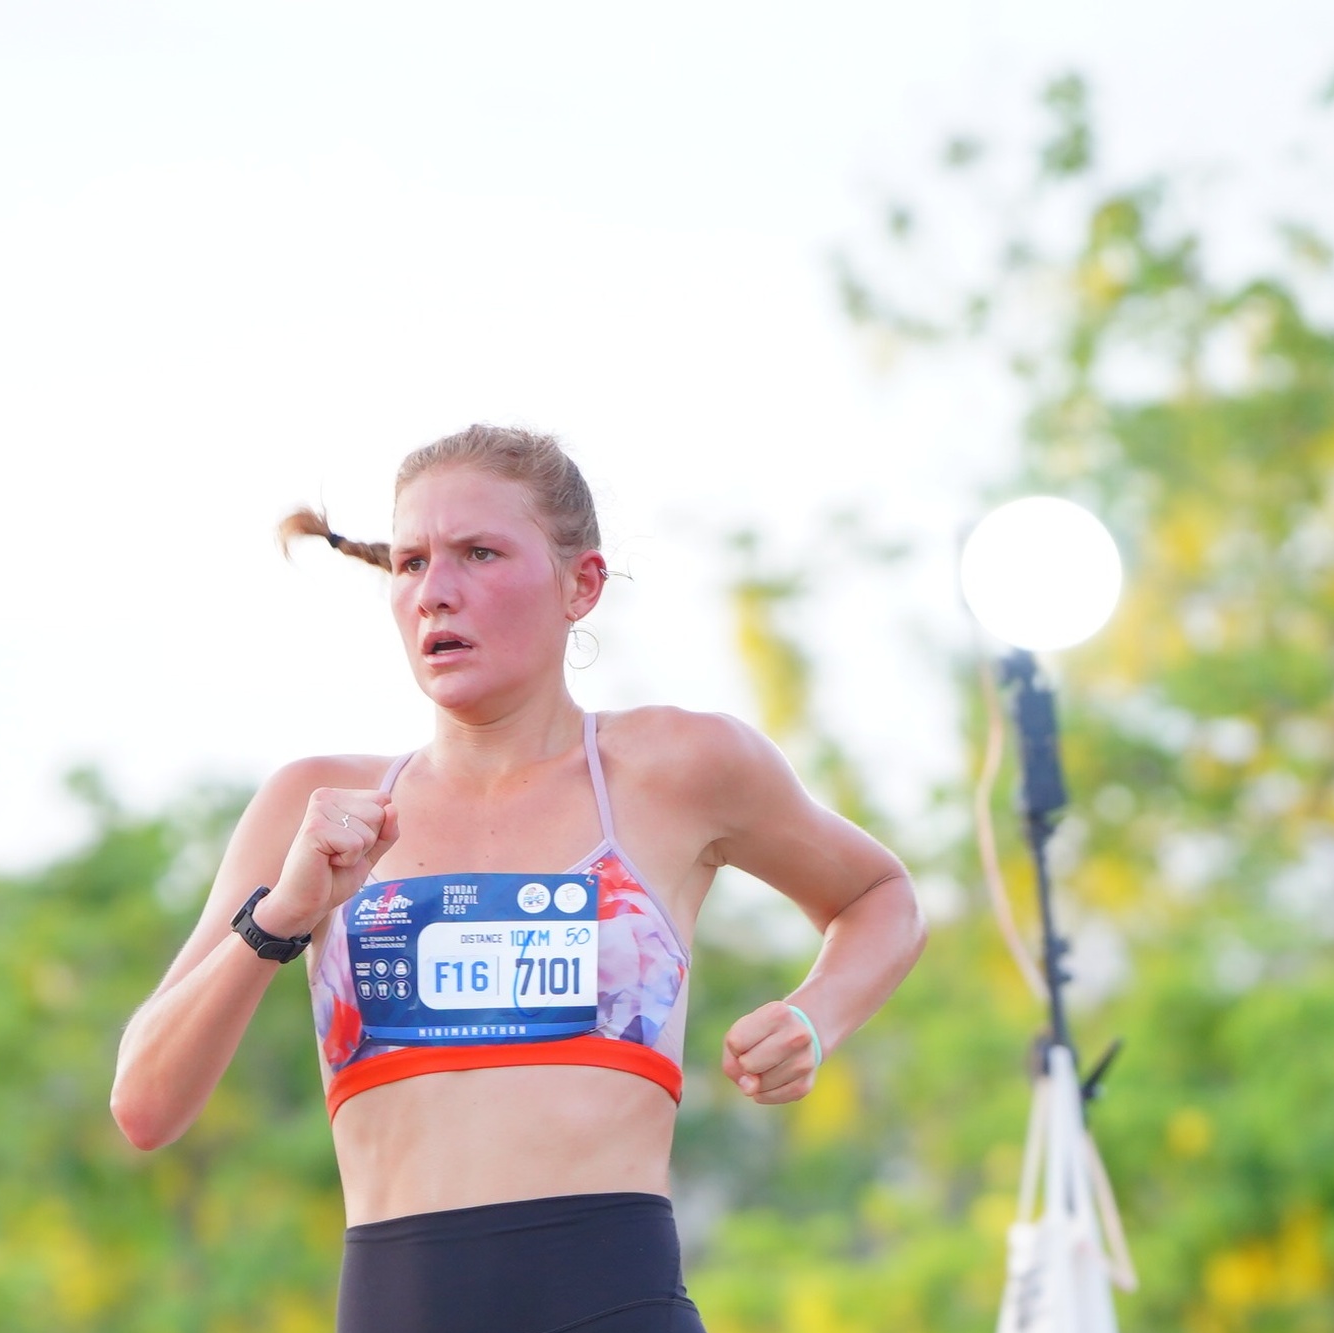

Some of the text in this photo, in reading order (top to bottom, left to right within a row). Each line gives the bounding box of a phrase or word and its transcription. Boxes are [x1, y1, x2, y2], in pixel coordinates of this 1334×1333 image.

[442, 885, 478, 895] SUNDAY
[443, 895, 479, 905] 6 APRIL
[442, 905, 467, 915] 2025
[460, 933, 503, 944] DISTANCE
[510, 929, 550, 947] 10KM
[565, 927, 591, 947] 50
[435, 960, 489, 994] F16
[515, 957, 580, 996] 7101
[418, 1025, 527, 1038] MINIMARATHON
